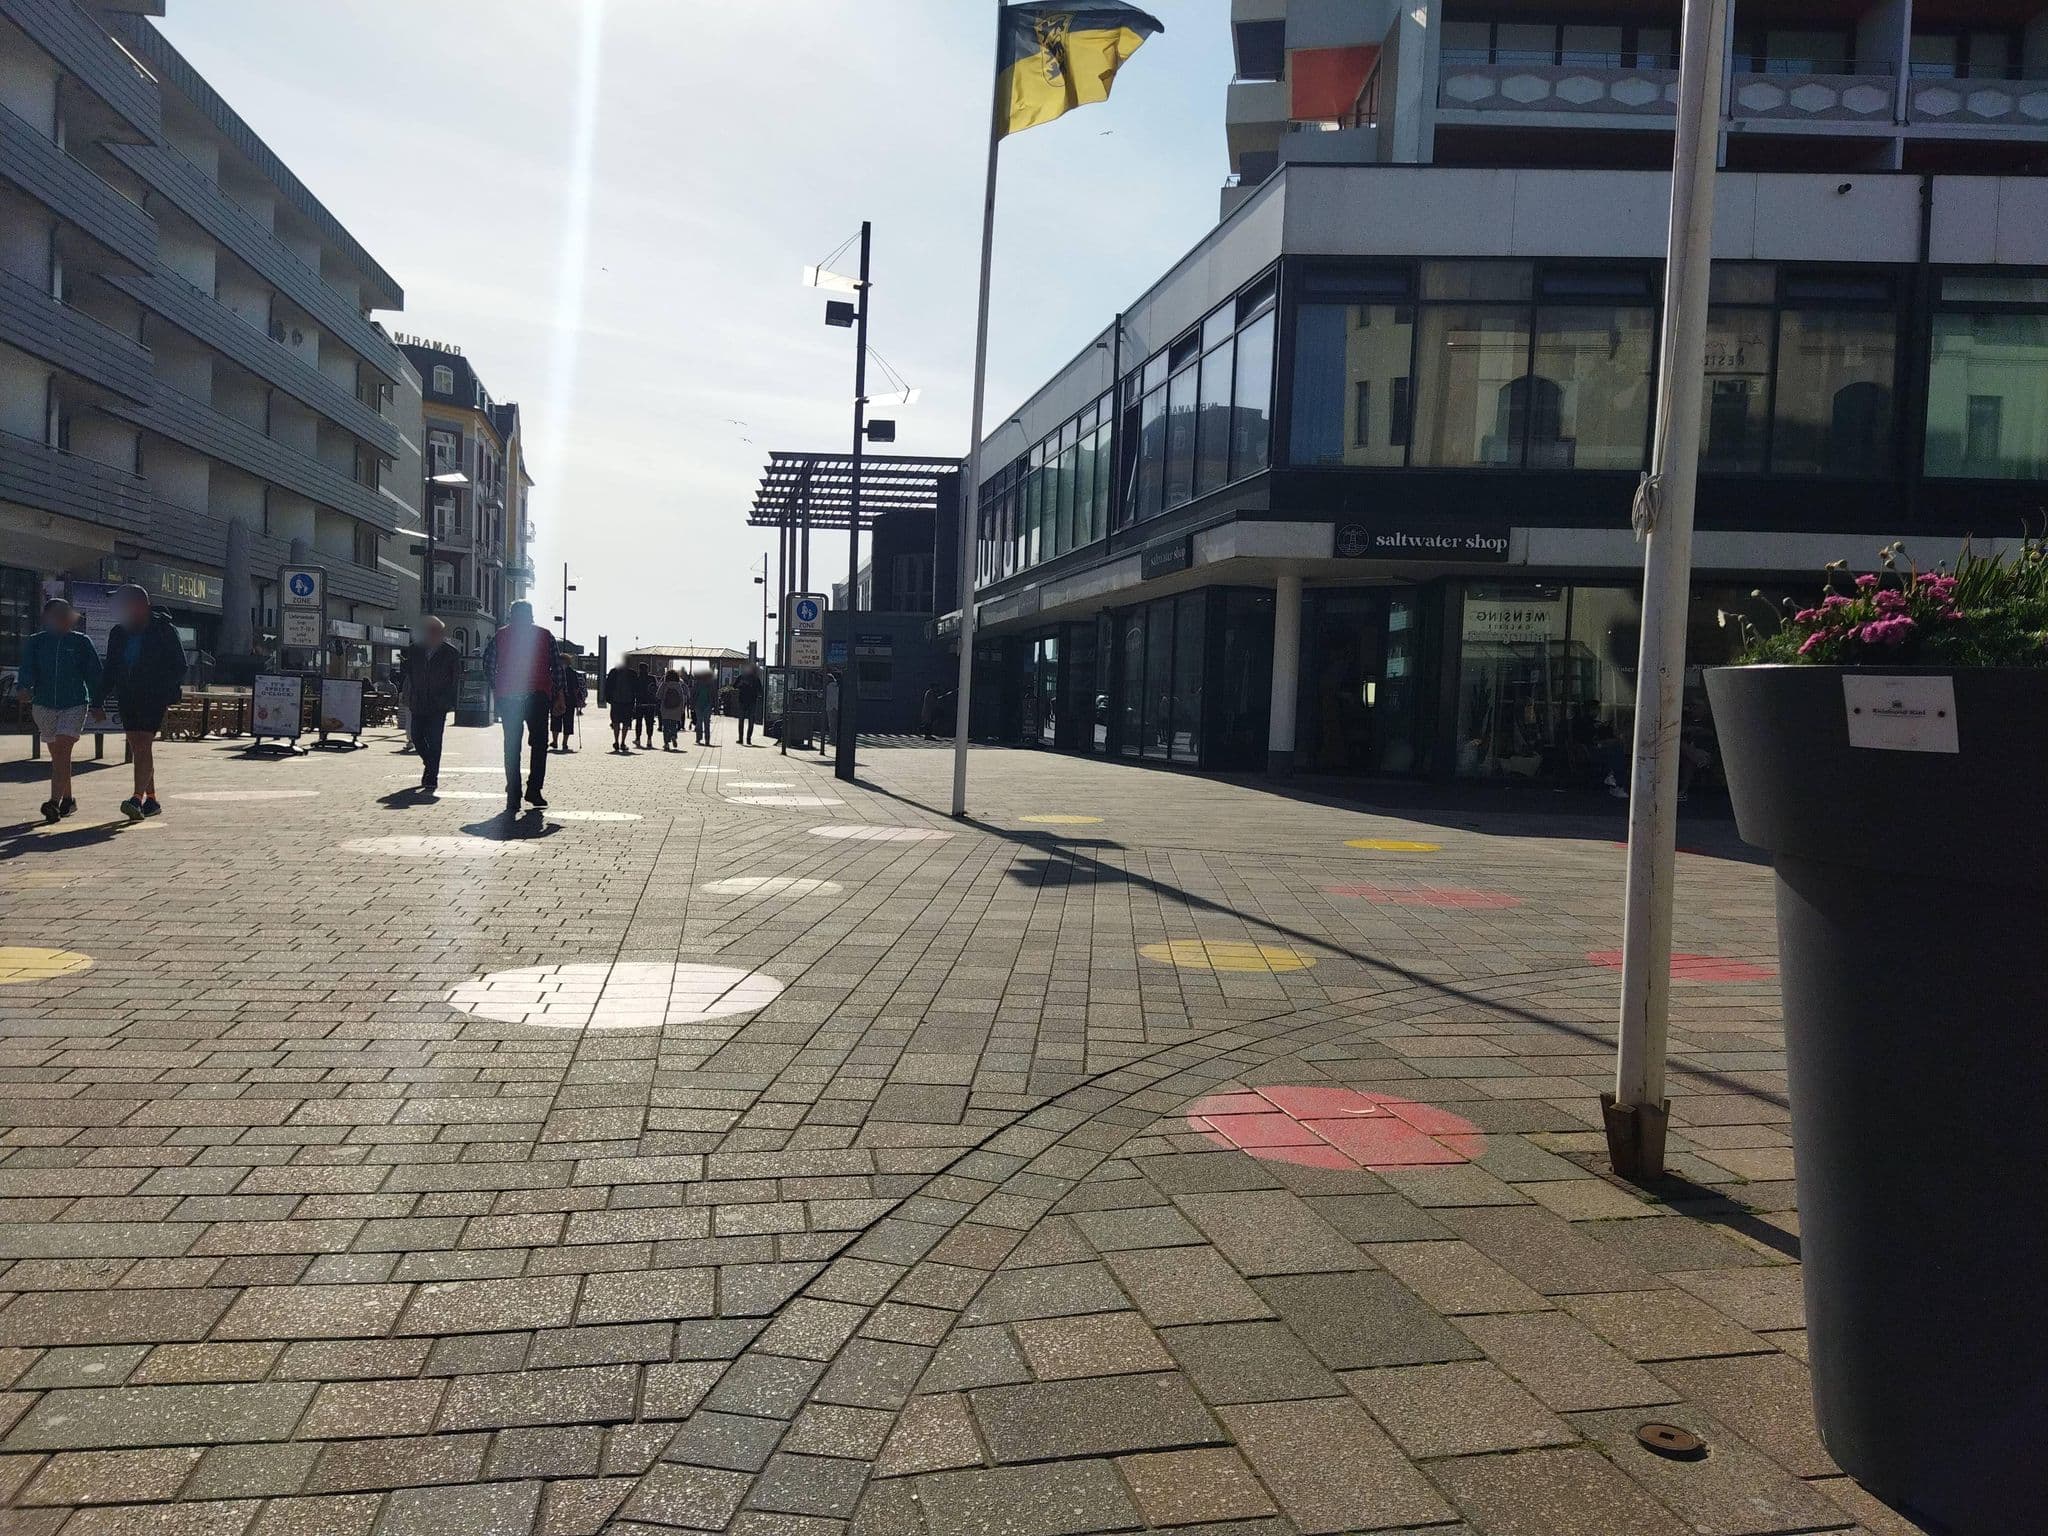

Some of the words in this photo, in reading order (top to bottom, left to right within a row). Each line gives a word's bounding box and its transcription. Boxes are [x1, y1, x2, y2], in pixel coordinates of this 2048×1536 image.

[394, 331, 462, 356] MIRAMAR
[1375, 532, 1462, 548] saltwater
[1465, 533, 1508, 553] shop
[161, 571, 176, 593] ALT
[178, 575, 206, 599] BERLIN
